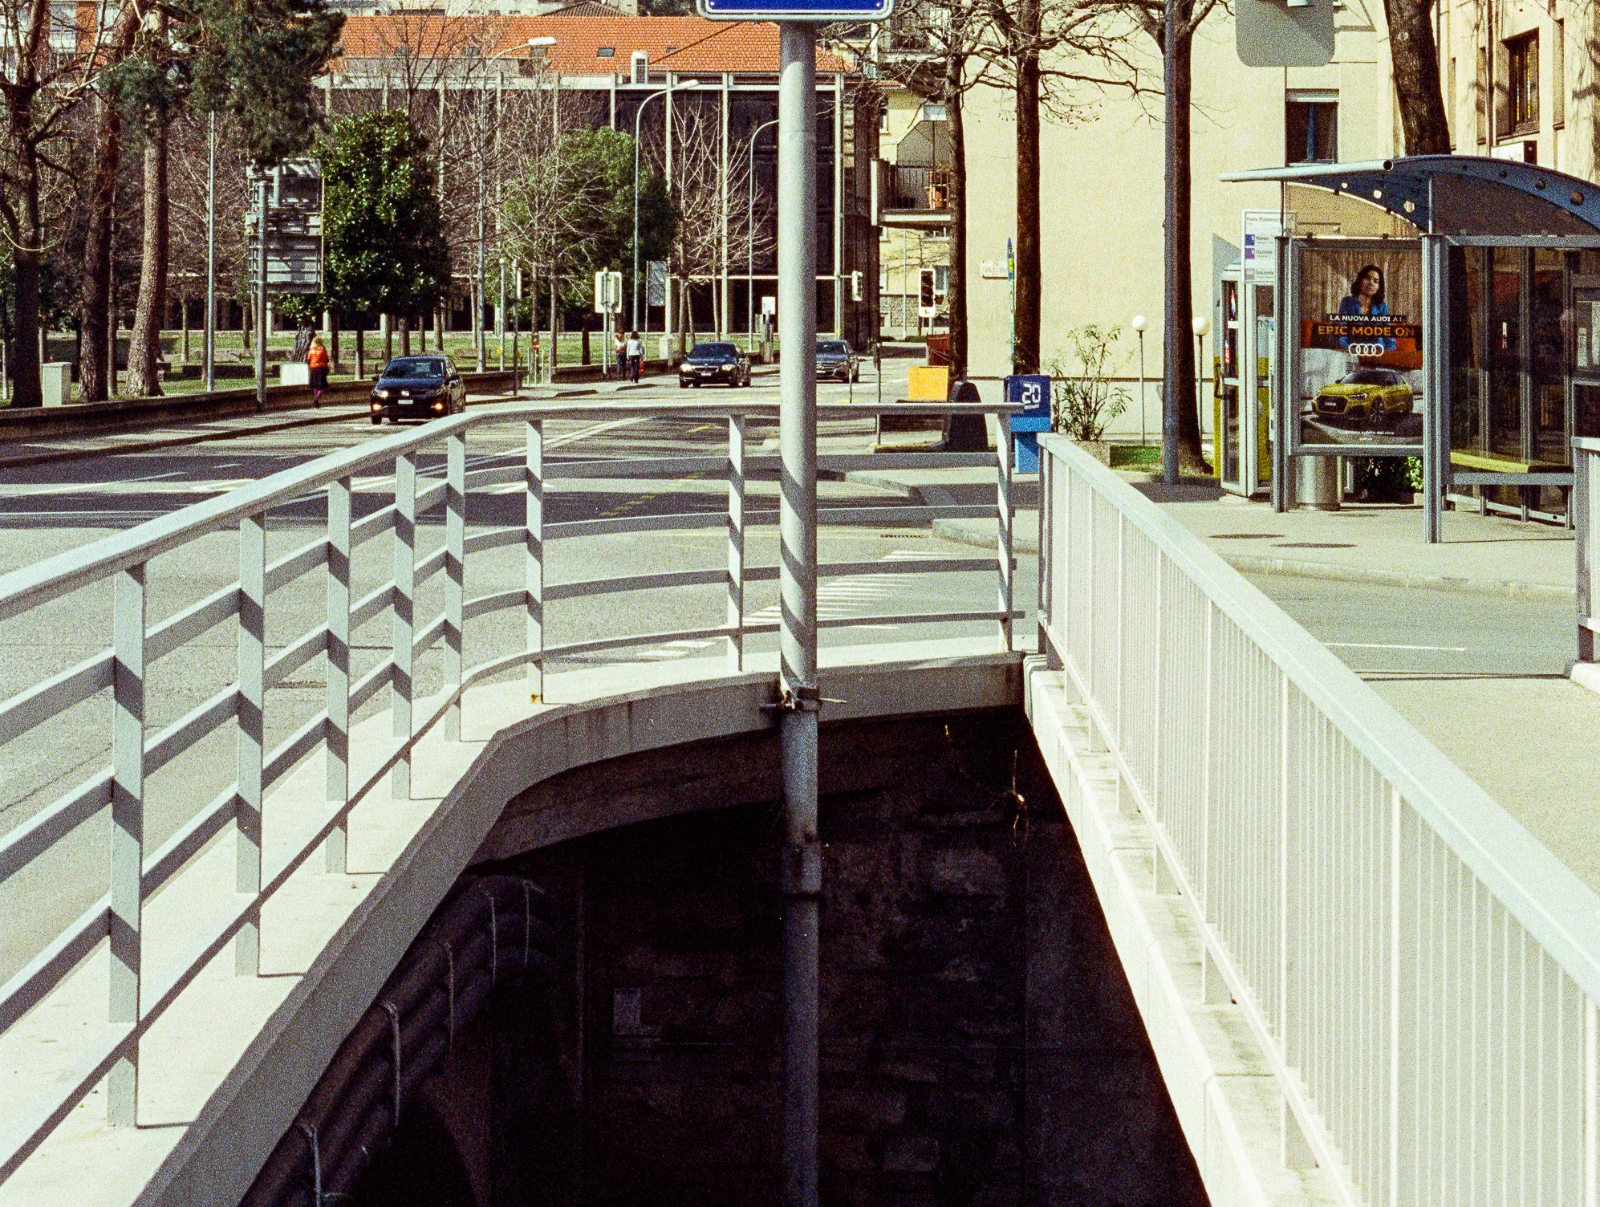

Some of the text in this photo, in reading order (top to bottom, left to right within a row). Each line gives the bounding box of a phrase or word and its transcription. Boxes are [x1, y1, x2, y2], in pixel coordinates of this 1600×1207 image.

[1317, 325, 1415, 337] EPIC MODE ON
[1021, 383, 1041, 404] 20
